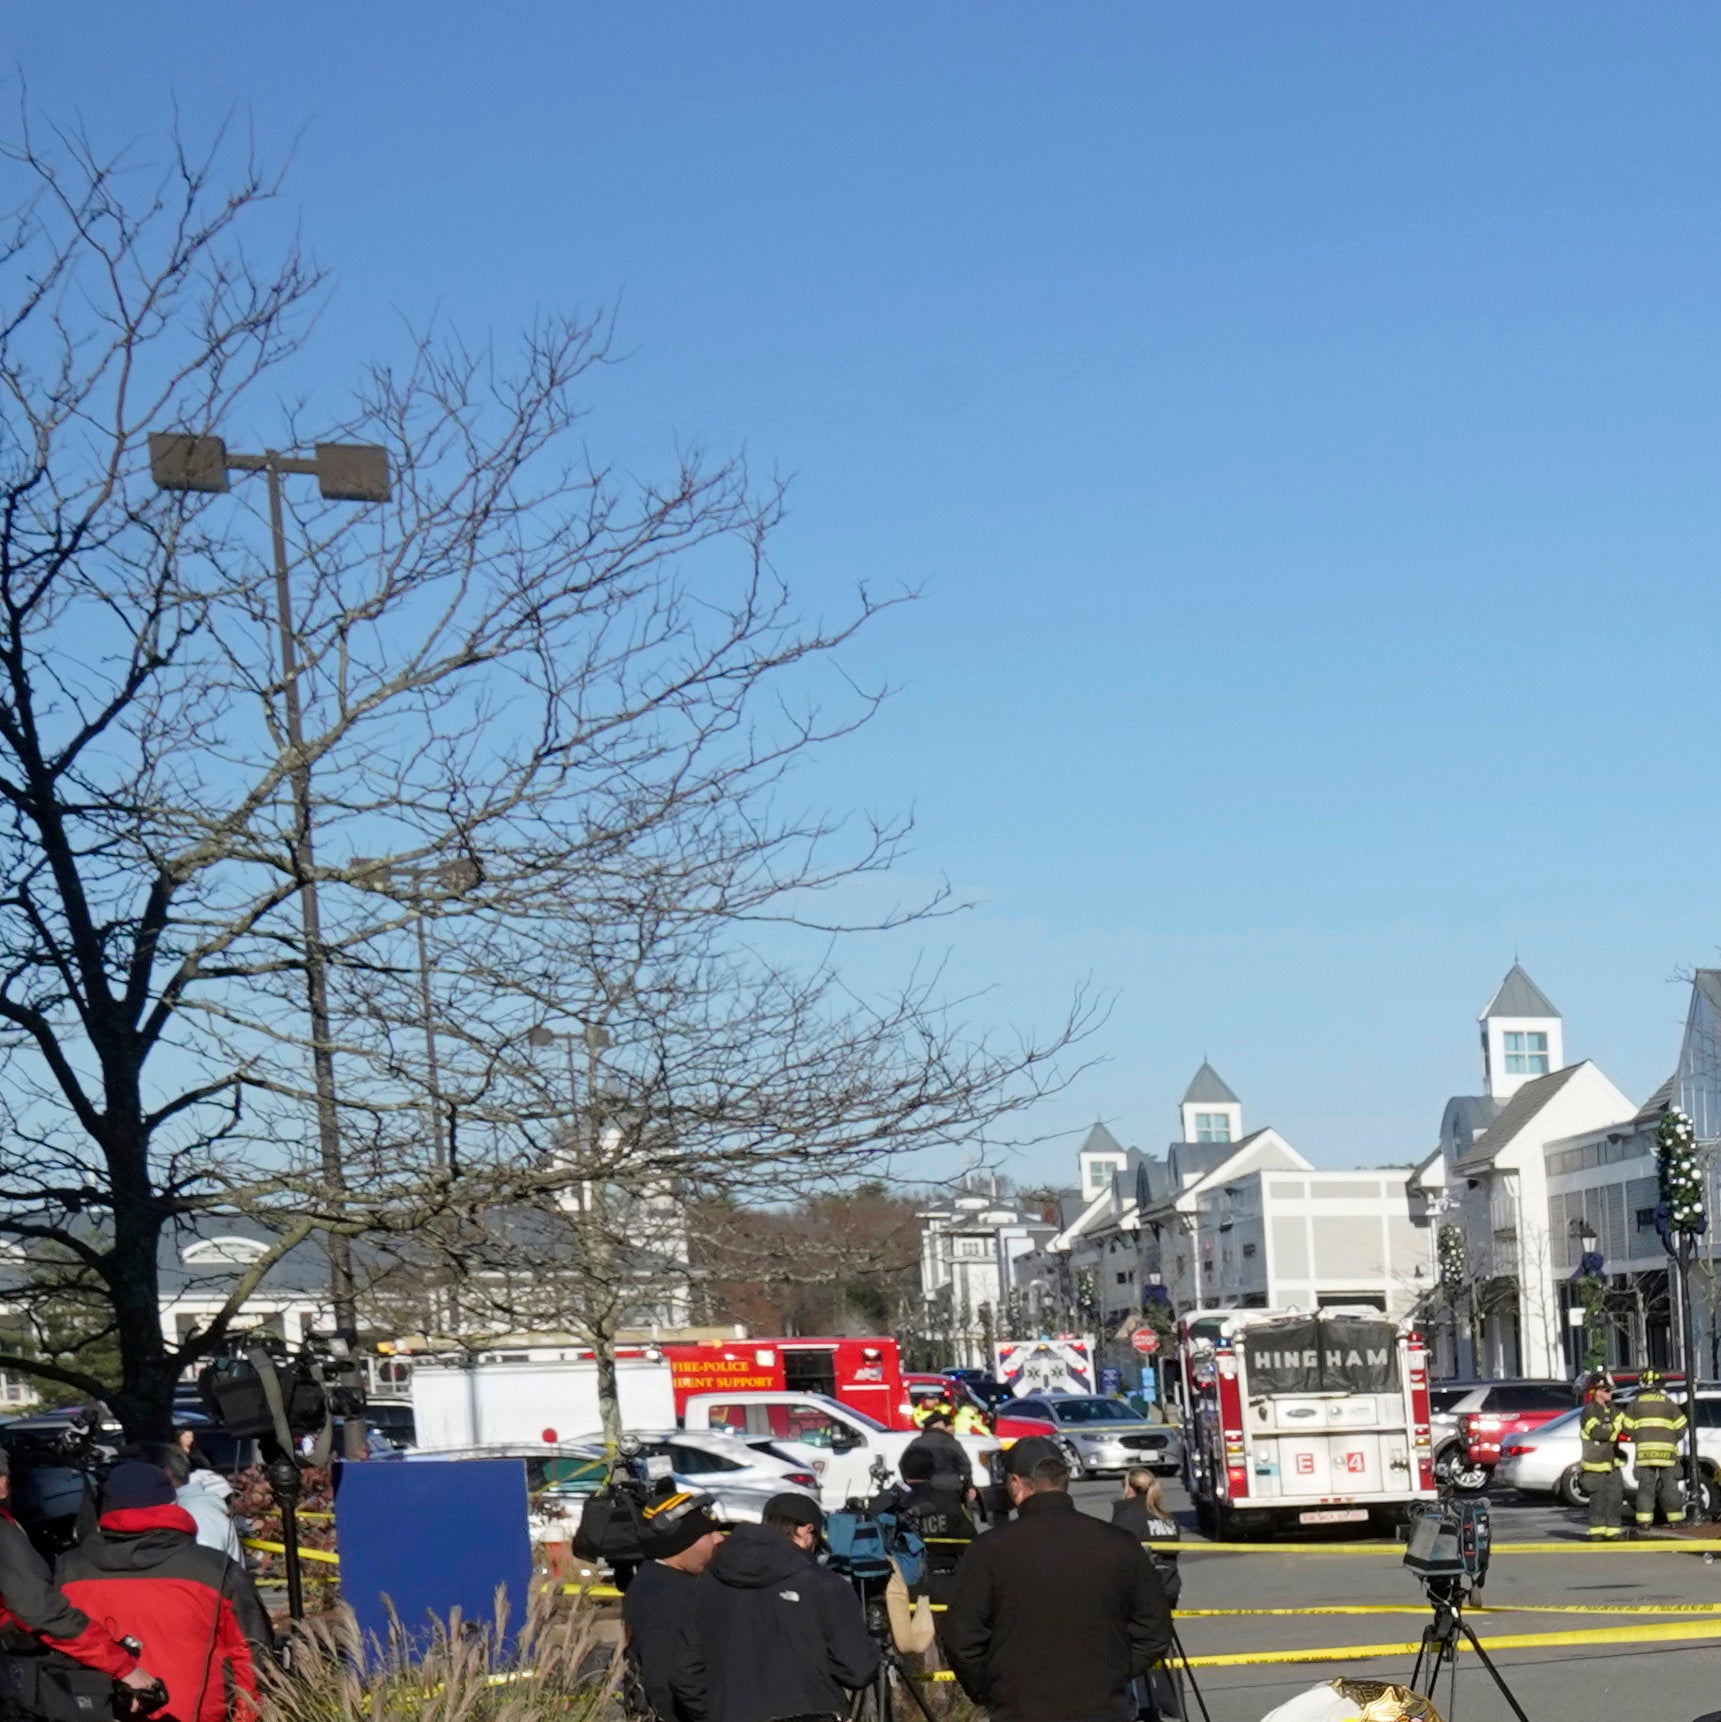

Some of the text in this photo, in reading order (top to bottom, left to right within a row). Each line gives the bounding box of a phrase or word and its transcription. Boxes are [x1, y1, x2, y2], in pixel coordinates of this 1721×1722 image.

[1255, 1349, 1388, 1369] HINGHAM
[672, 1361, 749, 1373] FIRE-POLICE
[717, 1376, 774, 1388] SUPPORT
[1298, 1454, 1363, 1473] E 4
